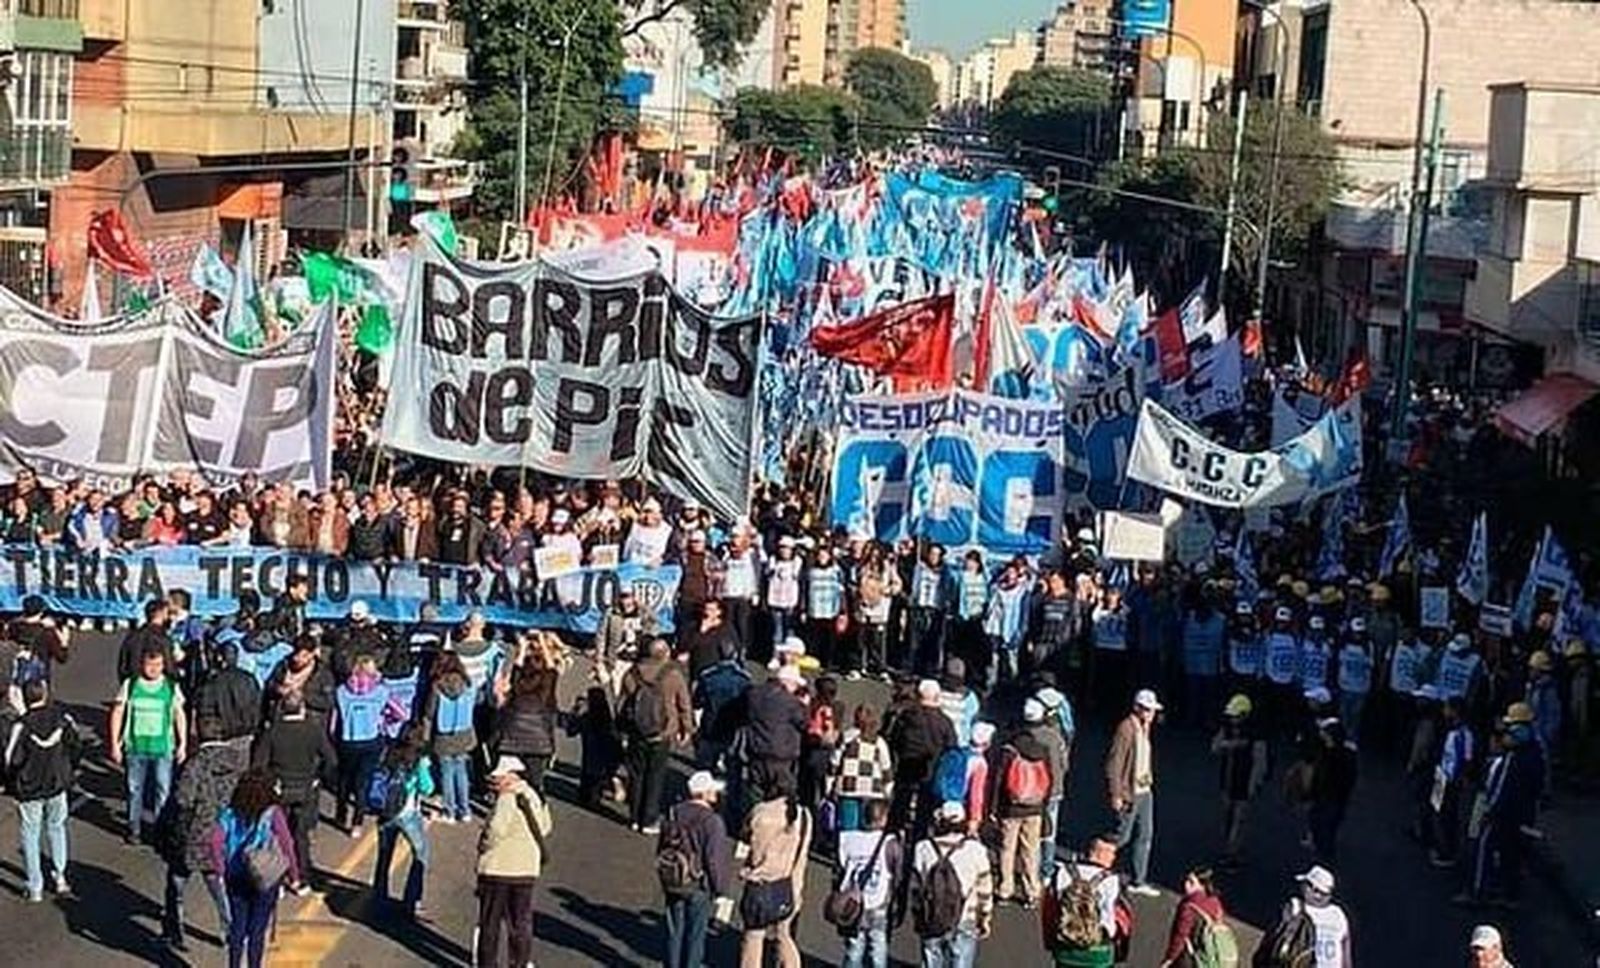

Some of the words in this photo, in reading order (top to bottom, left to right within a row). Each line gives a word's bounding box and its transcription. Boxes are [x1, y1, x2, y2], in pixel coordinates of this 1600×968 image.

[0, 336, 320, 472] CTEP
[429, 366, 536, 446] de
[4, 554, 164, 603] TIERRA
[200, 556, 350, 602] TECHO
[373, 563, 397, 600] Y
